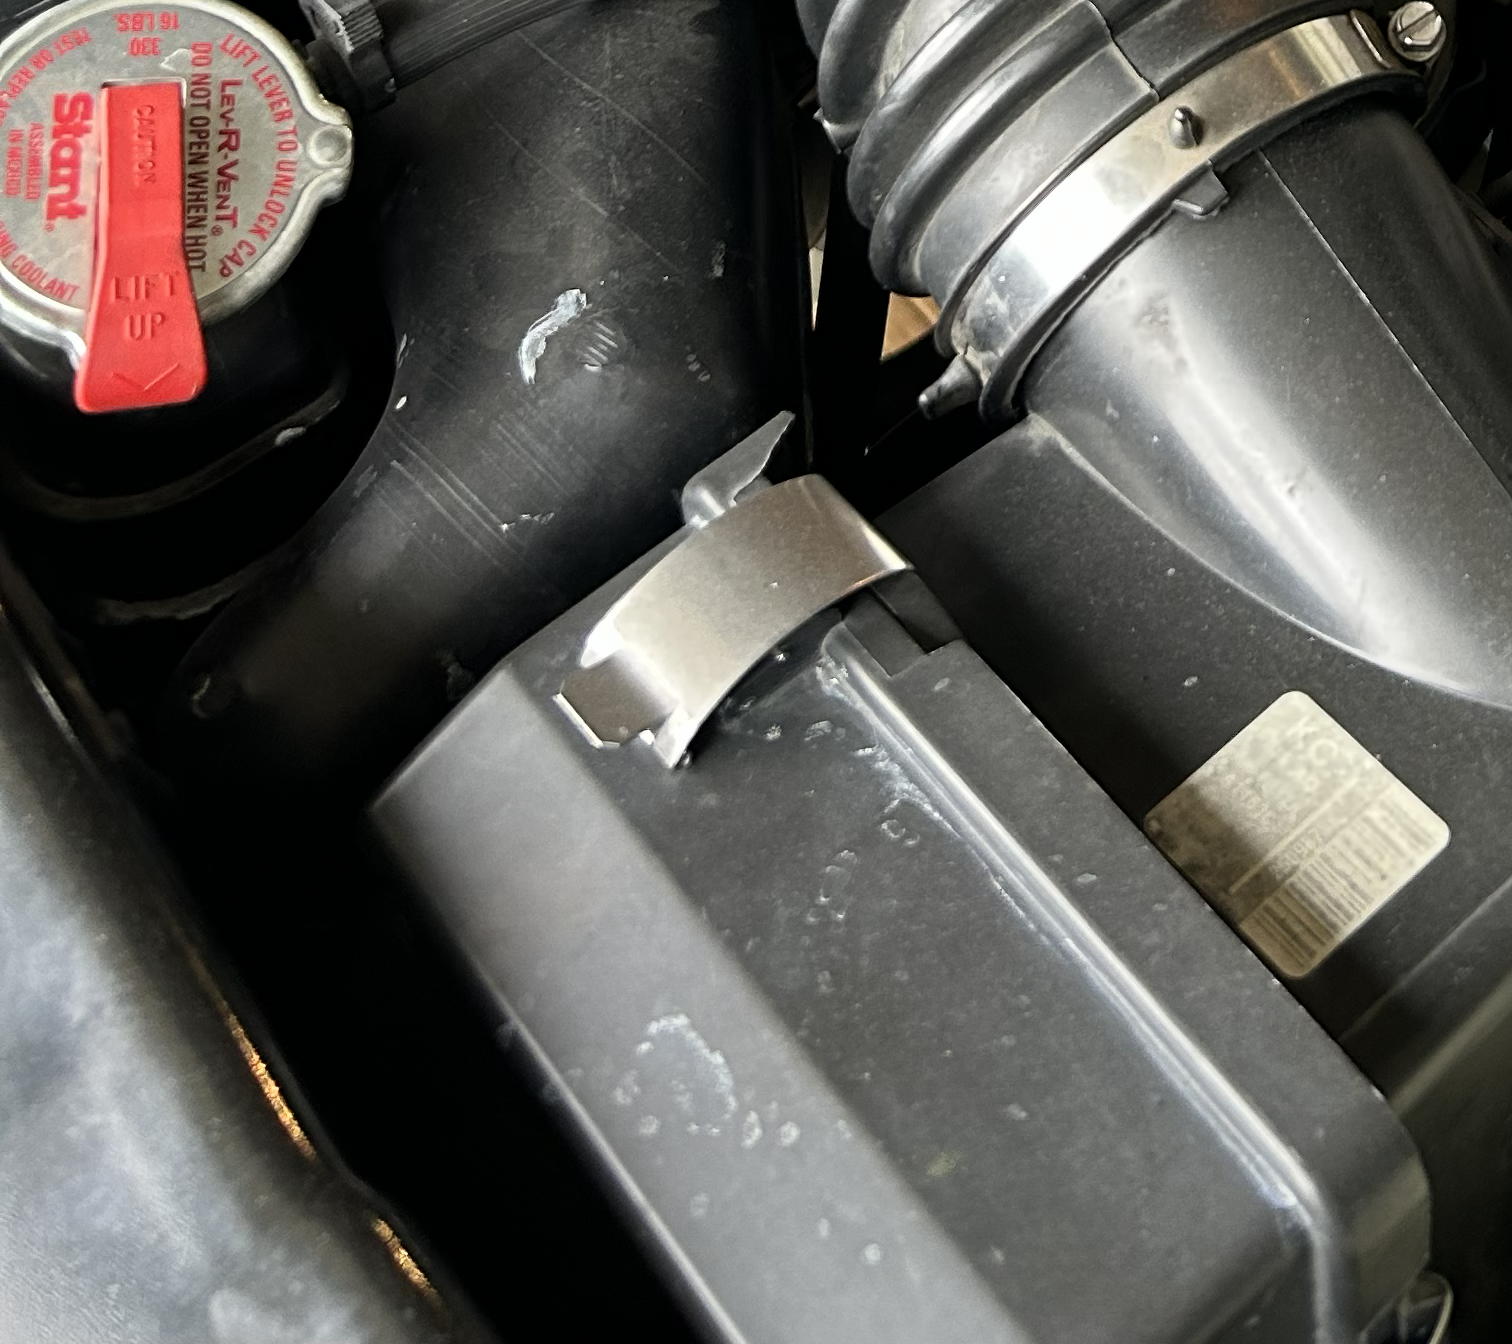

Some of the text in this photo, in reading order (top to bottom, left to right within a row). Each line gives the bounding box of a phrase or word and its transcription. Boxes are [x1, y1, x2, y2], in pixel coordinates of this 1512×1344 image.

[27, 49, 54, 70] OR
[54, 27, 92, 56] TEST
[129, 36, 162, 56] 330
[5, 128, 23, 197] IN MEXICO
[25, 122, 44, 201] ASSEMBLED
[134, 104, 157, 185] CAUTION
[184, 42, 213, 273] DO NOT OPEN WHEN HOT
[217, 33, 298, 279] LIFT LEVER TO UNLOCK CAP
[12, 253, 80, 303] COOLANT
[111, 273, 177, 303] LIFT
[124, 312, 165, 340] UP
